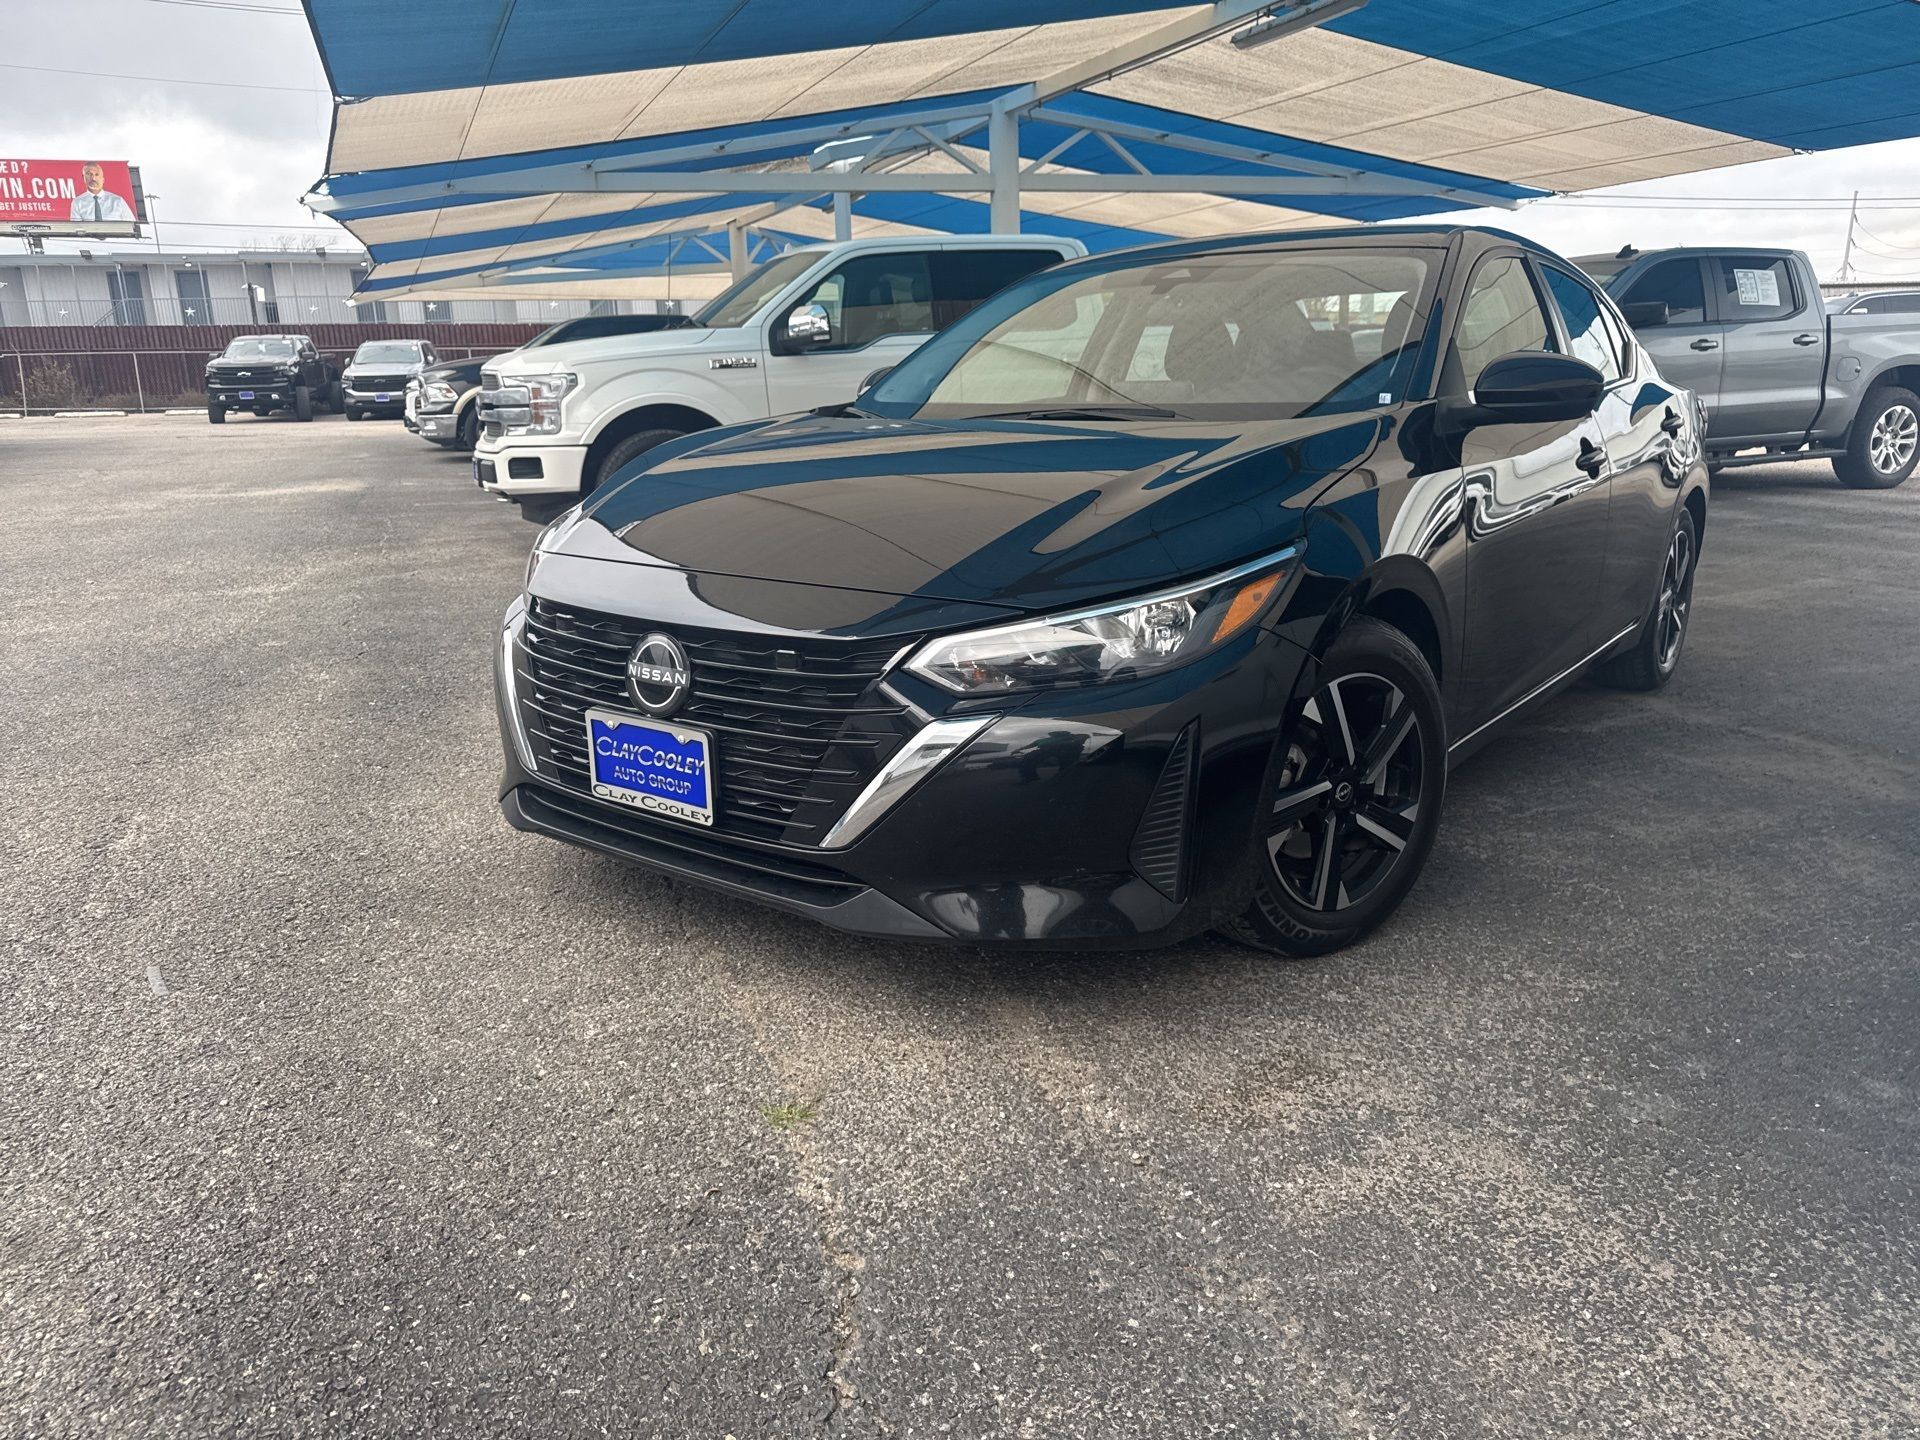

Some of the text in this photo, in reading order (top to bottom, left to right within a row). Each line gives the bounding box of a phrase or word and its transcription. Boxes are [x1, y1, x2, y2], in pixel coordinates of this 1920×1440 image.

[0, 161, 28, 174] ED?
[19, 202, 55, 211] JUSTICE.
[628, 663, 687, 685] NISSAN
[614, 765, 692, 795] AUTO GROUP
[592, 783, 712, 823] CLAY COOLEY
